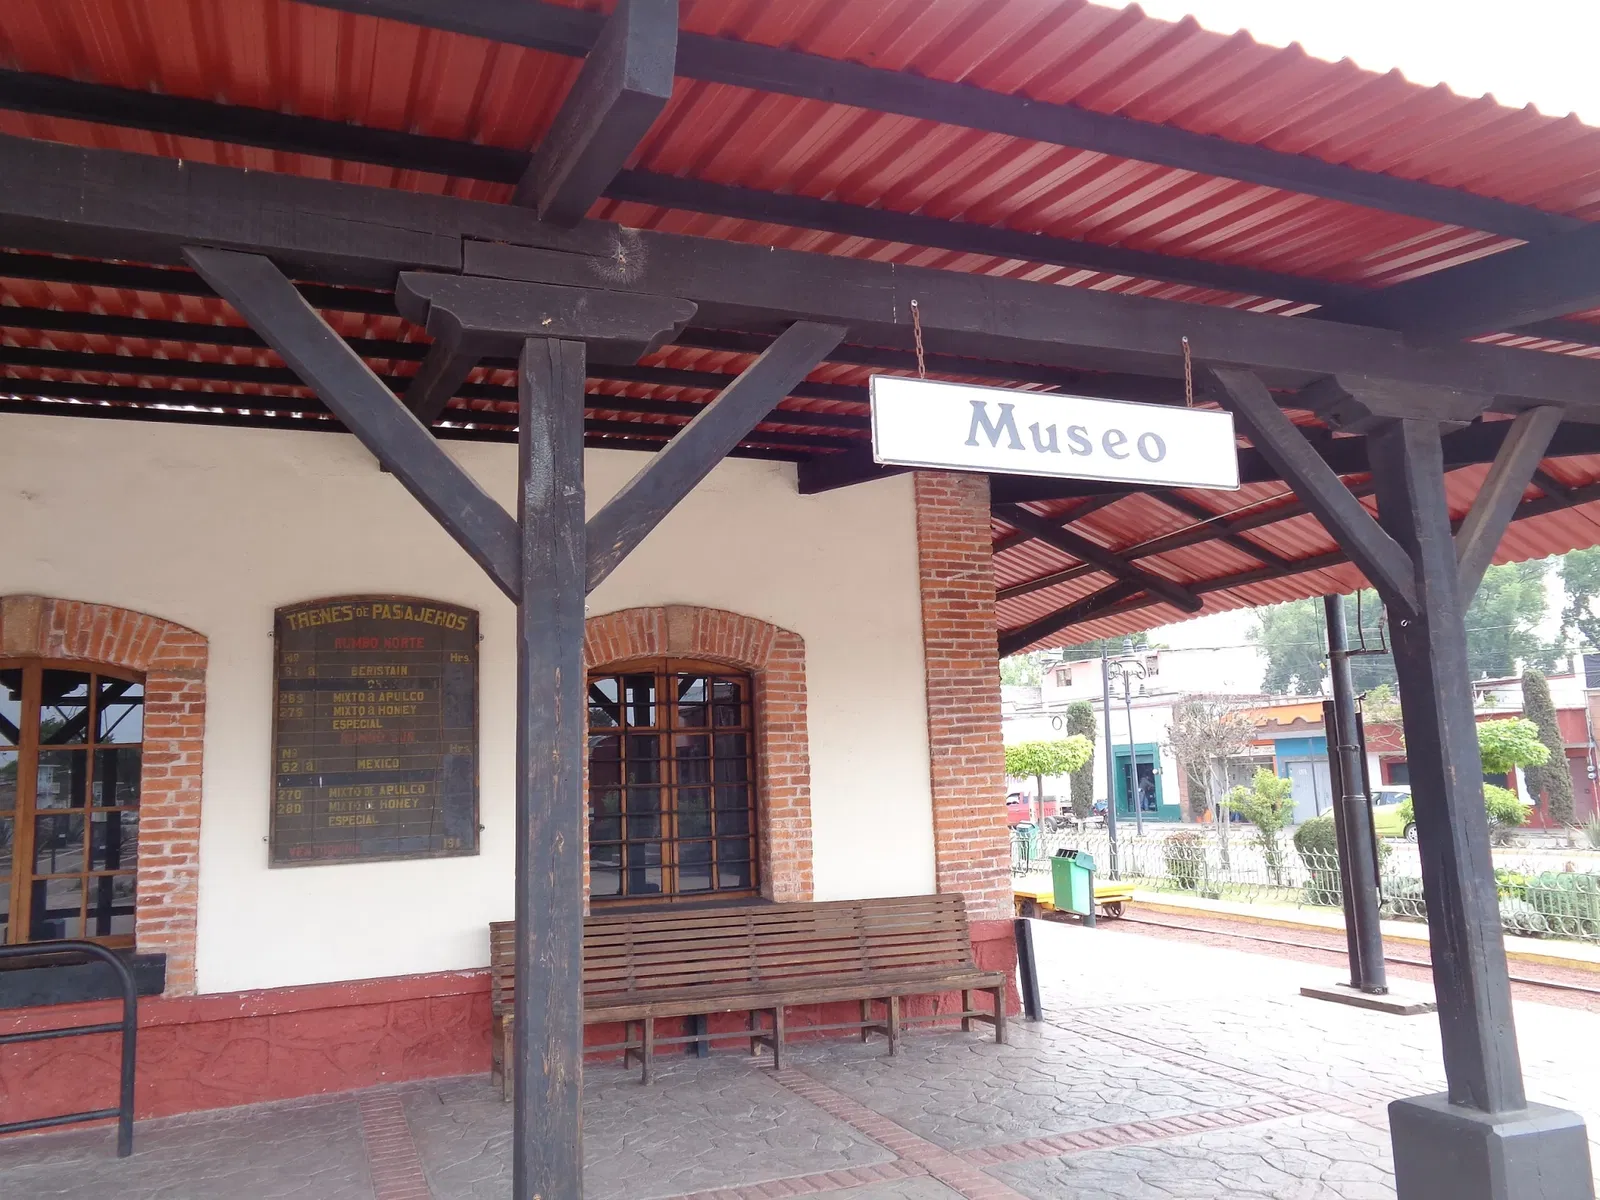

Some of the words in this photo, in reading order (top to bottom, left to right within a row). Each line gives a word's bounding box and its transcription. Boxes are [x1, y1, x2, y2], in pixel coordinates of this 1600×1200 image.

[964, 400, 1167, 463] Museo
[286, 605, 352, 631] TRENES
[356, 607, 369, 617] DE
[372, 604, 469, 631] PASAJEROS
[334, 637, 379, 649] RUMBO
[384, 637, 425, 649] NORTE
[351, 666, 408, 676] BERISTAIN
[333, 692, 365, 703] MIXTO
[378, 691, 425, 702] APULCO
[333, 706, 365, 717] MIXTO
[377, 705, 417, 716] HONEY
[333, 719, 383, 730] ESPECIAL
[281, 762, 298, 772] 62
[357, 758, 400, 769] MEXICO
[278, 789, 302, 800] 270
[328, 787, 361, 798] MIXTO
[379, 784, 425, 795] APULCO
[278, 803, 302, 814] 280
[328, 801, 361, 813] MIXTO
[380, 798, 419, 809] HONEY
[328, 815, 379, 826] ESPECIAL
